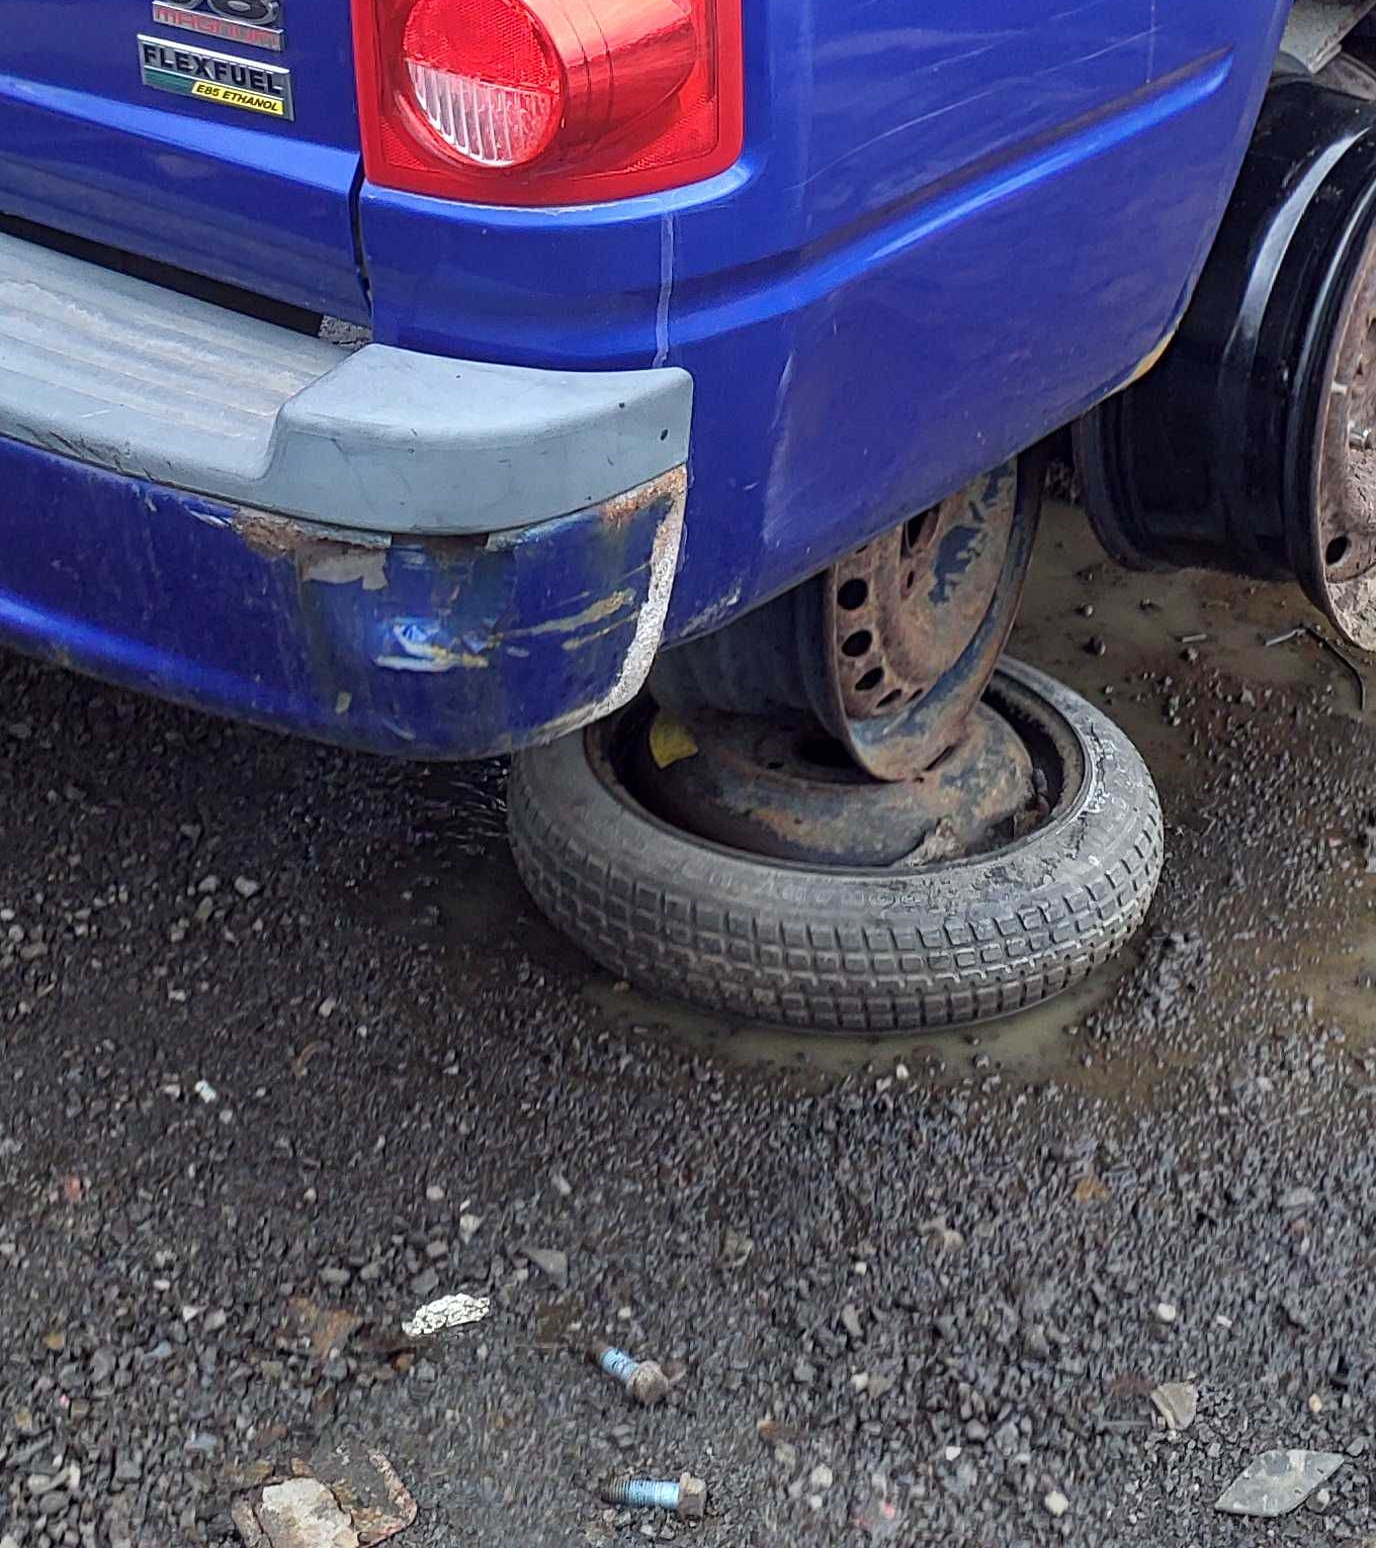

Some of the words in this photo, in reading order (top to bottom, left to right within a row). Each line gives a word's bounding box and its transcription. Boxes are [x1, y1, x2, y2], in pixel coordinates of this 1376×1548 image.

[143, 43, 284, 96] FLEXFUEL
[195, 83, 220, 98] E85
[221, 89, 280, 113] ETHANOL
